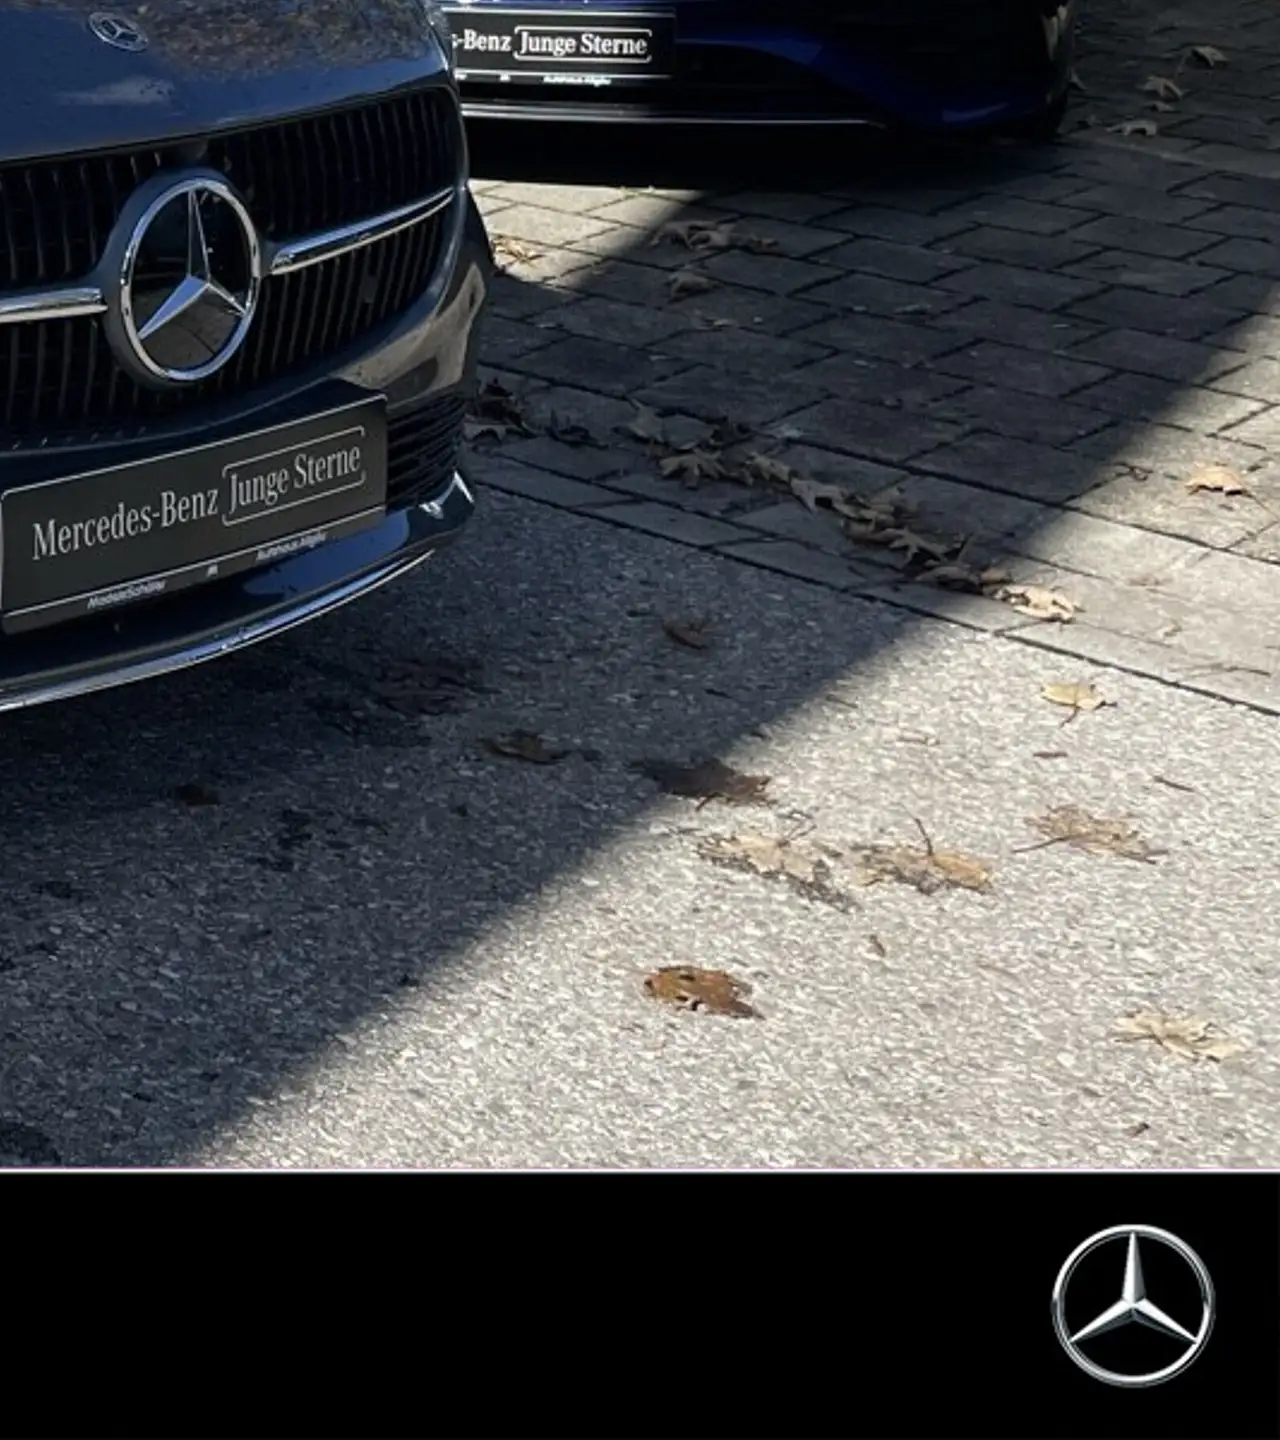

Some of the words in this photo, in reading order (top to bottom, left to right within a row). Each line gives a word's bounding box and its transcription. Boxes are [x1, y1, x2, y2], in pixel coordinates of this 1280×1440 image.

[519, 31, 577, 56] Junge
[580, 32, 648, 56] Sterne
[32, 489, 219, 561] Mercedes-Benz
[228, 467, 289, 515] Junge
[293, 445, 361, 489] Sterne
